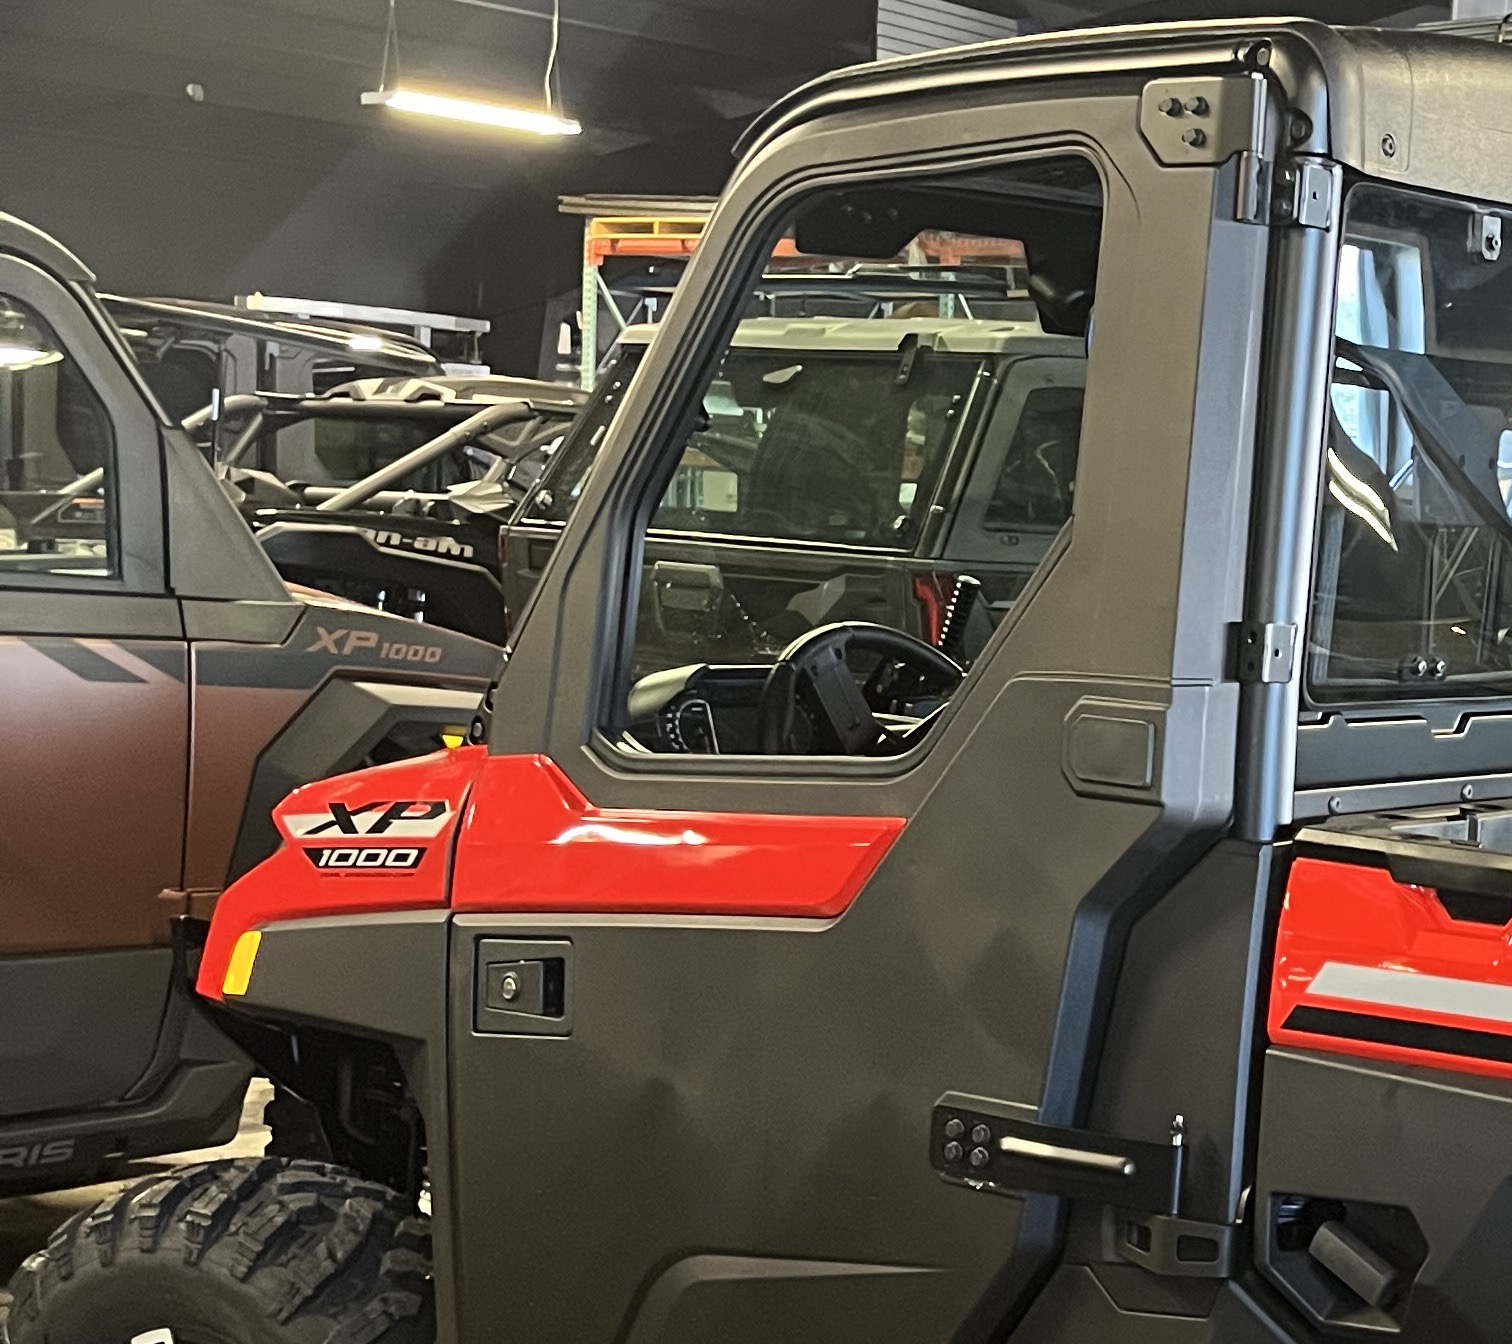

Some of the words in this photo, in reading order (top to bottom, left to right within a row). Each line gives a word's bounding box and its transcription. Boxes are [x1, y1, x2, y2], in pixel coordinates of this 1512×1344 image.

[305, 626, 379, 655] XP
[380, 641, 443, 663] 1000
[301, 801, 448, 835] XP
[318, 848, 419, 867] 1000
